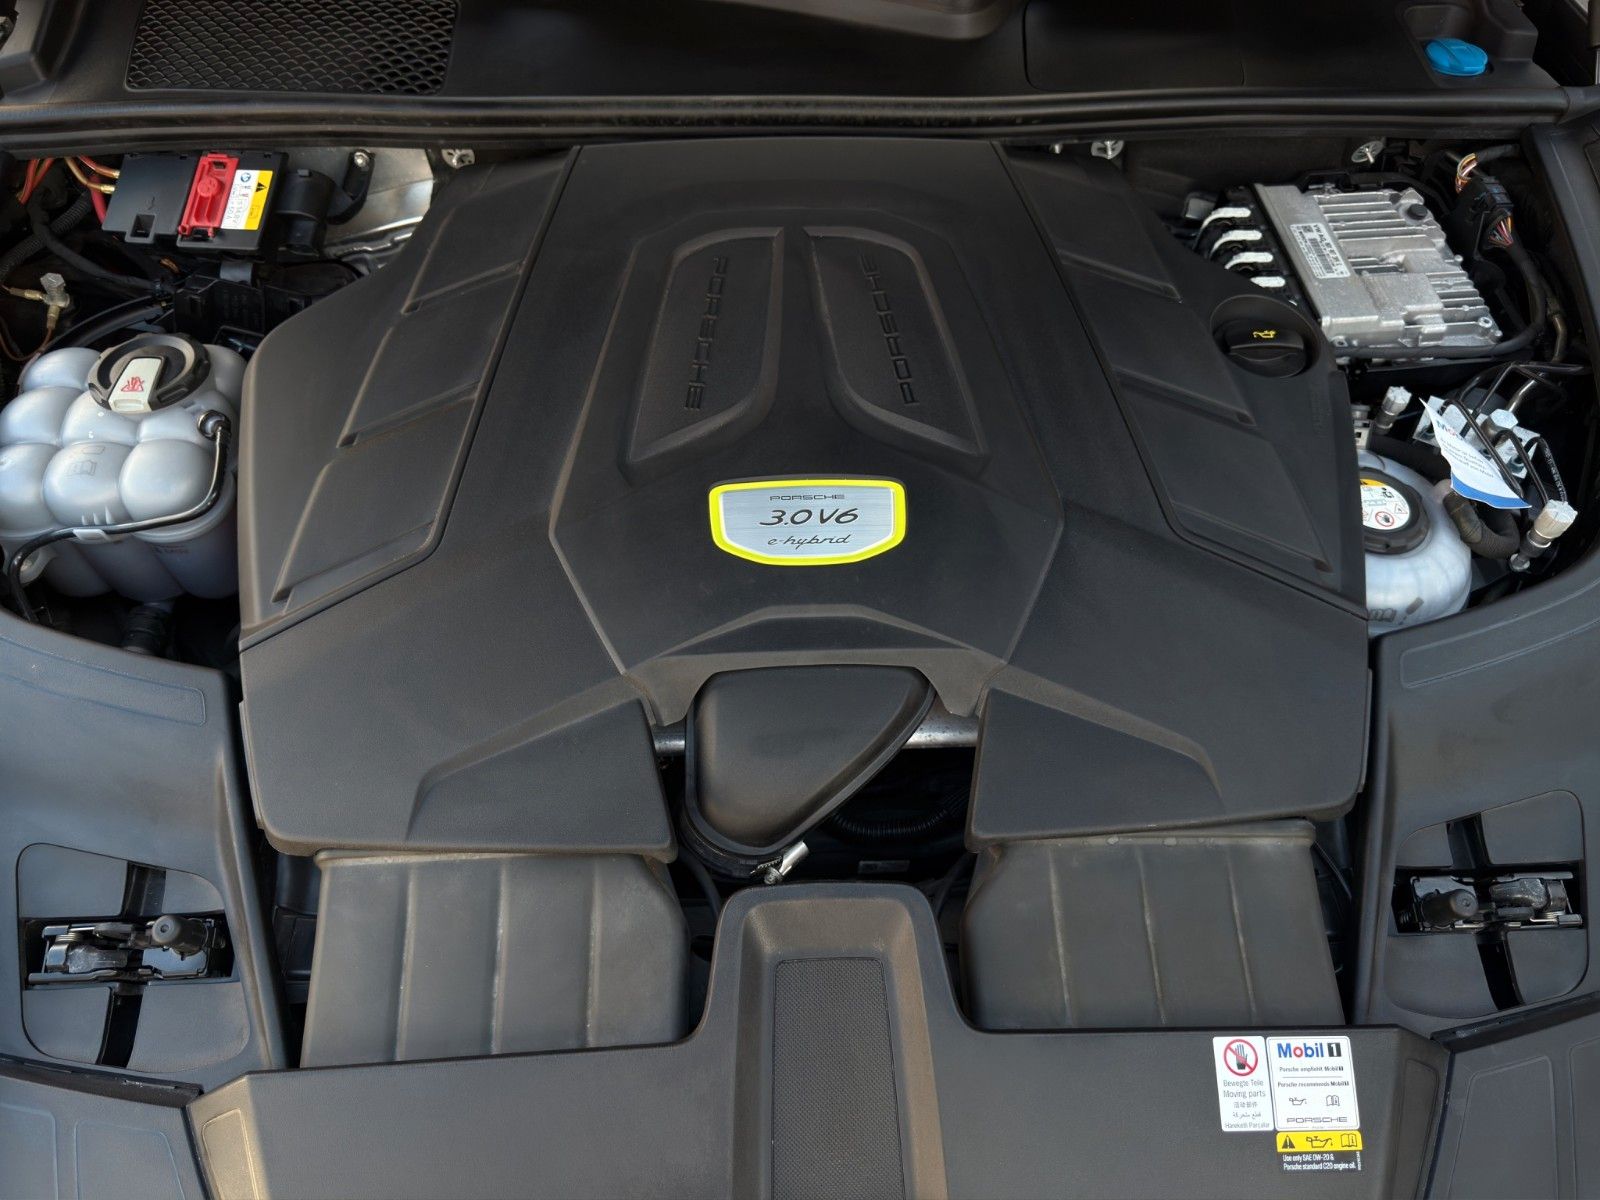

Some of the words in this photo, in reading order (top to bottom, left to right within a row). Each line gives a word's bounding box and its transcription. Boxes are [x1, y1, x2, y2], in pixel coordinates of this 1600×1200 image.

[685, 256, 729, 411] PORSCHE
[859, 252, 920, 406] PORSCHE
[759, 509, 813, 526] 3.0
[819, 508, 859, 525] V6
[767, 534, 851, 550] e-hybrid
[1277, 1042, 1325, 1058] Mobil
[1327, 1042, 1342, 1058] 1
[1223, 1079, 1249, 1088] Bewegte
[1250, 1079, 1264, 1087] Teile
[1223, 1090, 1248, 1099] Moving
[1248, 1090, 1266, 1099] parts
[1286, 1116, 1348, 1124] PORSCHE
[1282, 1154, 1292, 1162] Use
[1292, 1154, 1302, 1163] only
[1283, 1163, 1302, 1171] Porsche
[1302, 1162, 1323, 1170] standard
[1333, 1162, 1349, 1170] engine
